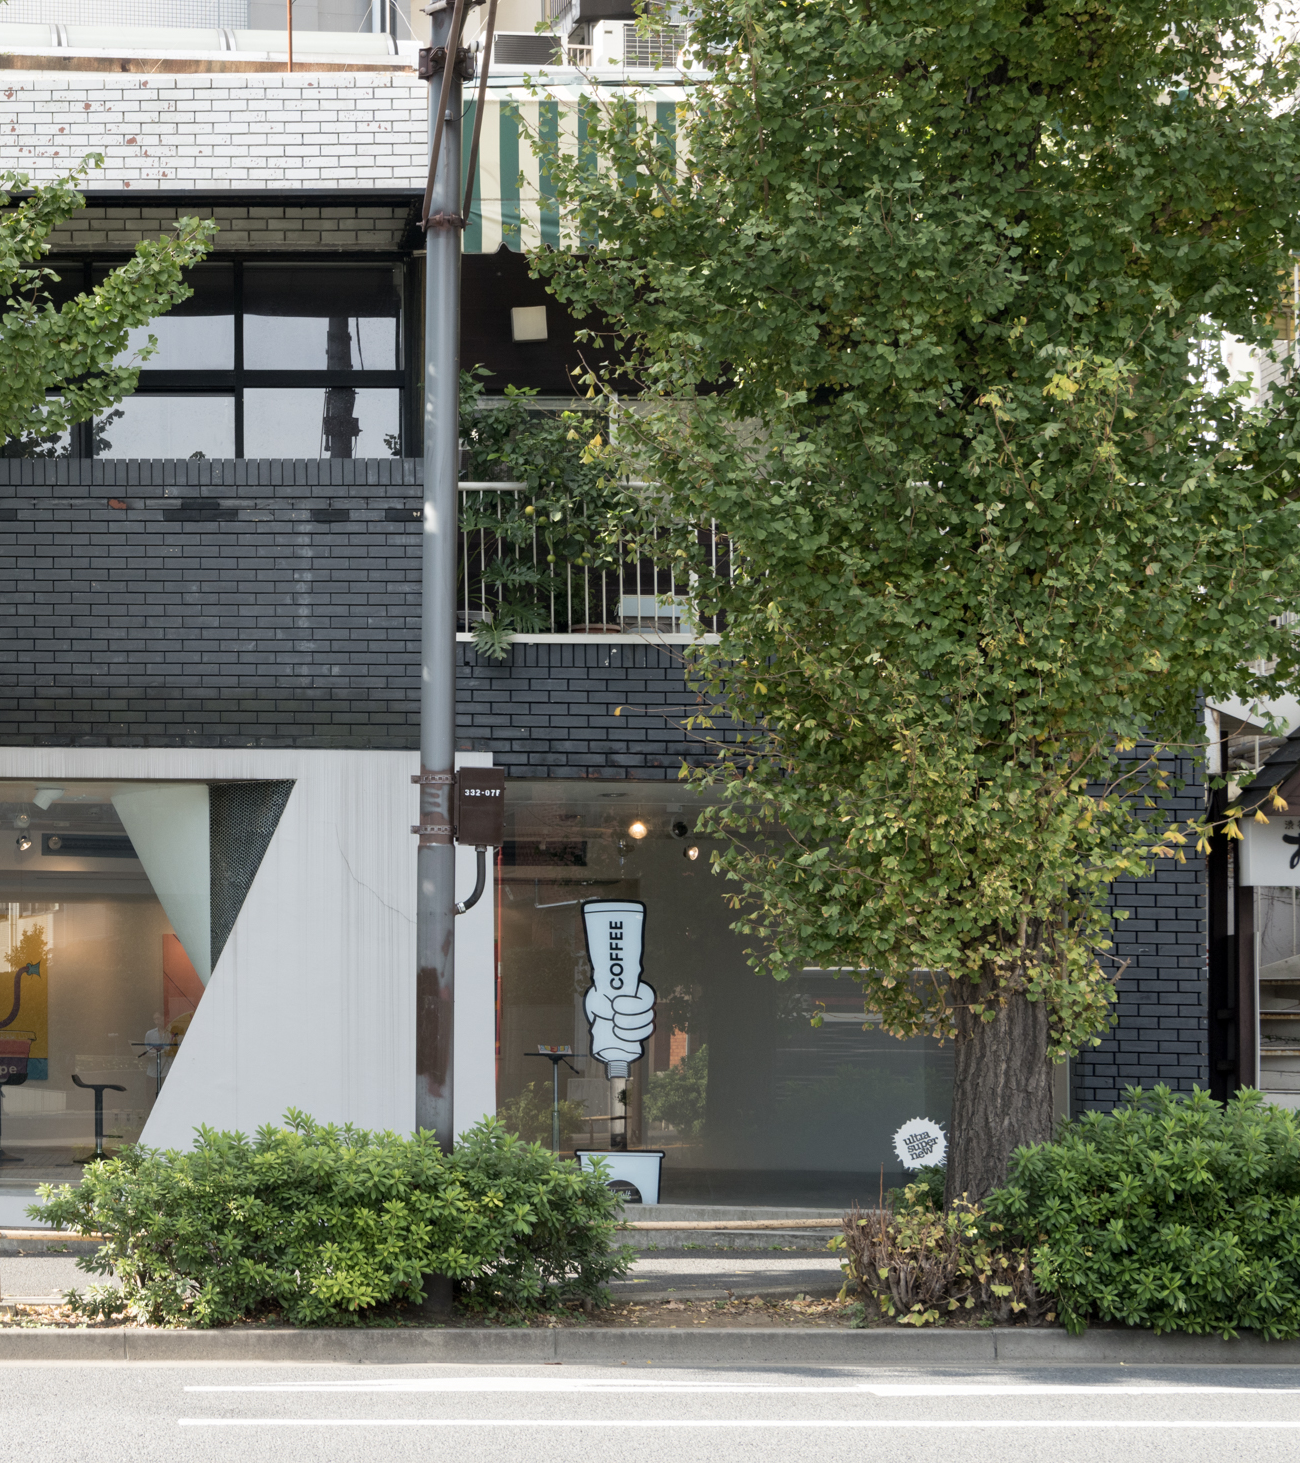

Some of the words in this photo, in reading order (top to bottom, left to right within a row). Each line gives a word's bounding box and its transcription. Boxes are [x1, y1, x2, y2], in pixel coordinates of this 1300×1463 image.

[464, 789, 501, 797] 332-07F
[609, 920, 624, 991] COFFEE
[903, 1131, 931, 1146] ultra
[907, 1136, 939, 1153] super
[909, 1145, 933, 1160] new
